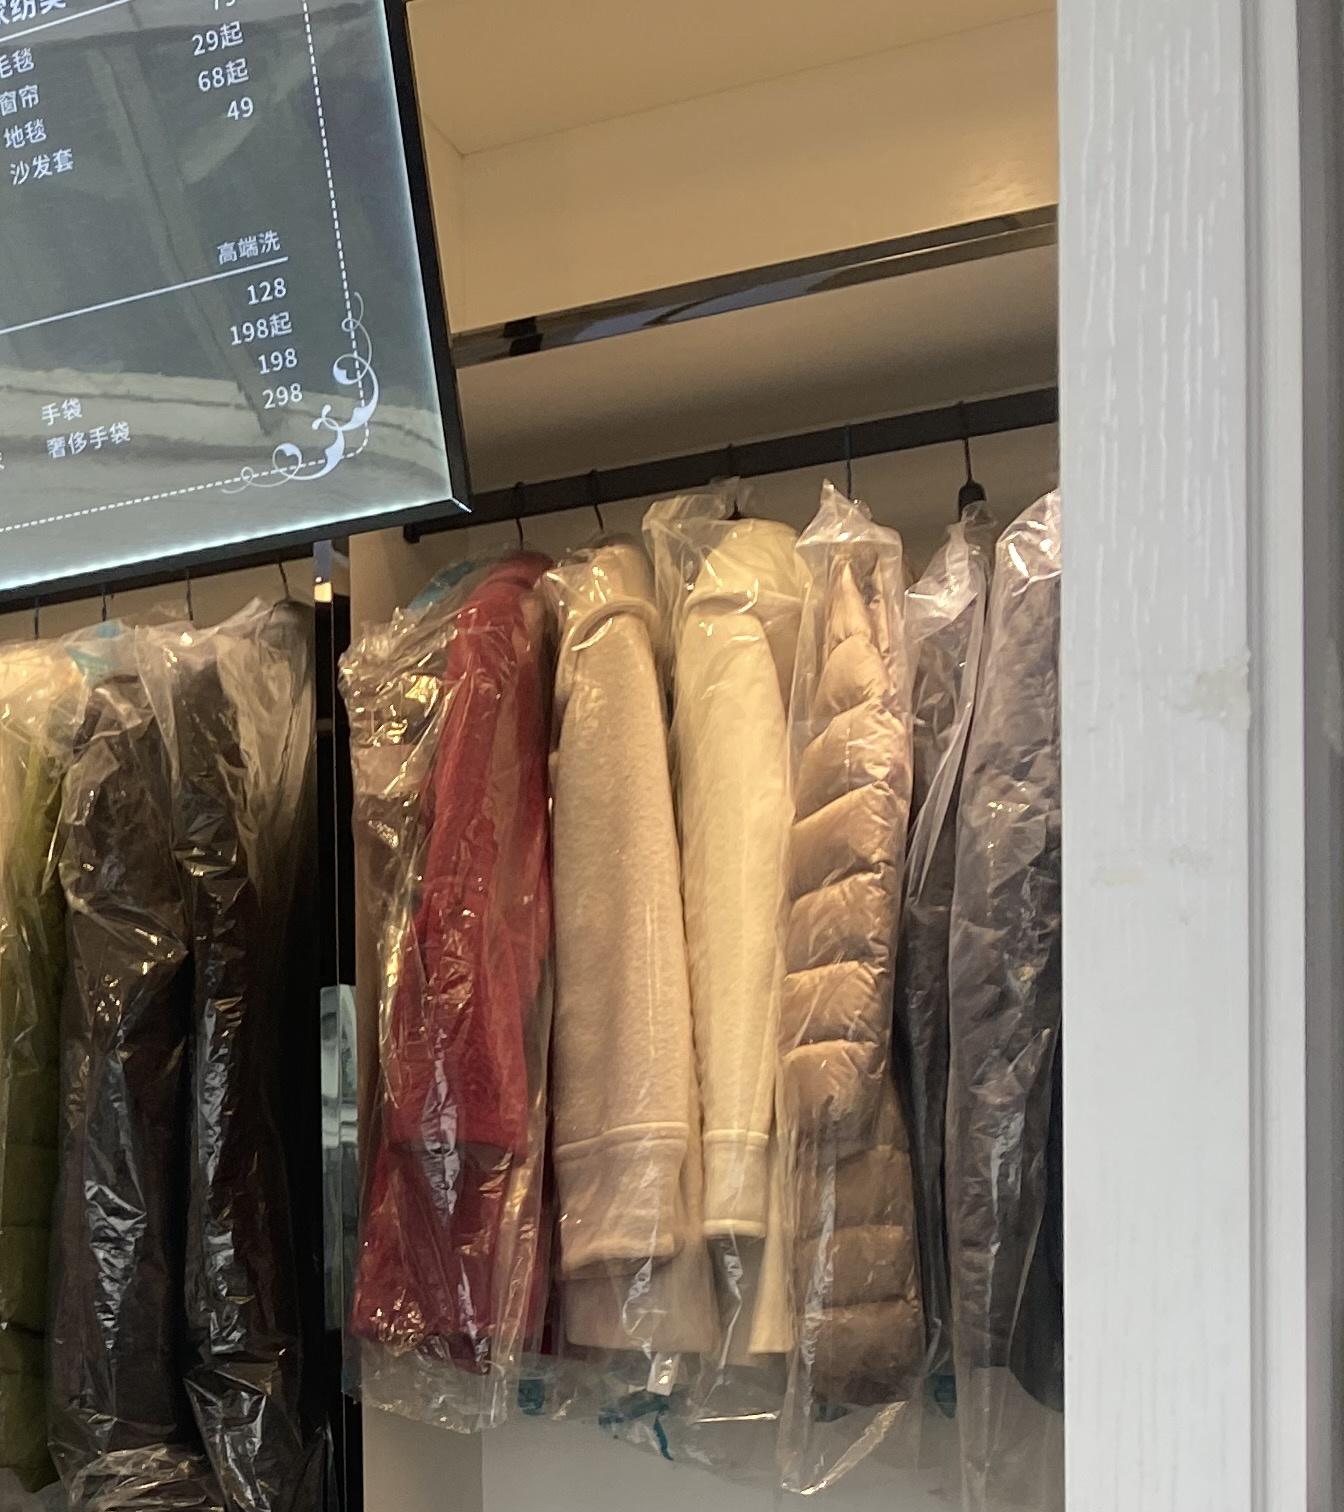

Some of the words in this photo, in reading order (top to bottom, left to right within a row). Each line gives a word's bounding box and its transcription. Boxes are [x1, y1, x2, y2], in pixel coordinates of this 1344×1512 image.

[192, 21, 244, 56] 29起
[198, 58, 250, 92] 68起
[226, 96, 254, 121] 49
[3, 118, 47, 150] 地毯
[10, 148, 74, 186] 沙发套
[216, 229, 281, 265] 高端洗
[247, 277, 287, 305] 128
[230, 311, 293, 345] 198起
[257, 348, 297, 375] 198
[40, 398, 83, 427] 手袋
[261, 383, 303, 410] 298
[46, 420, 131, 460] 奢侈手袋
